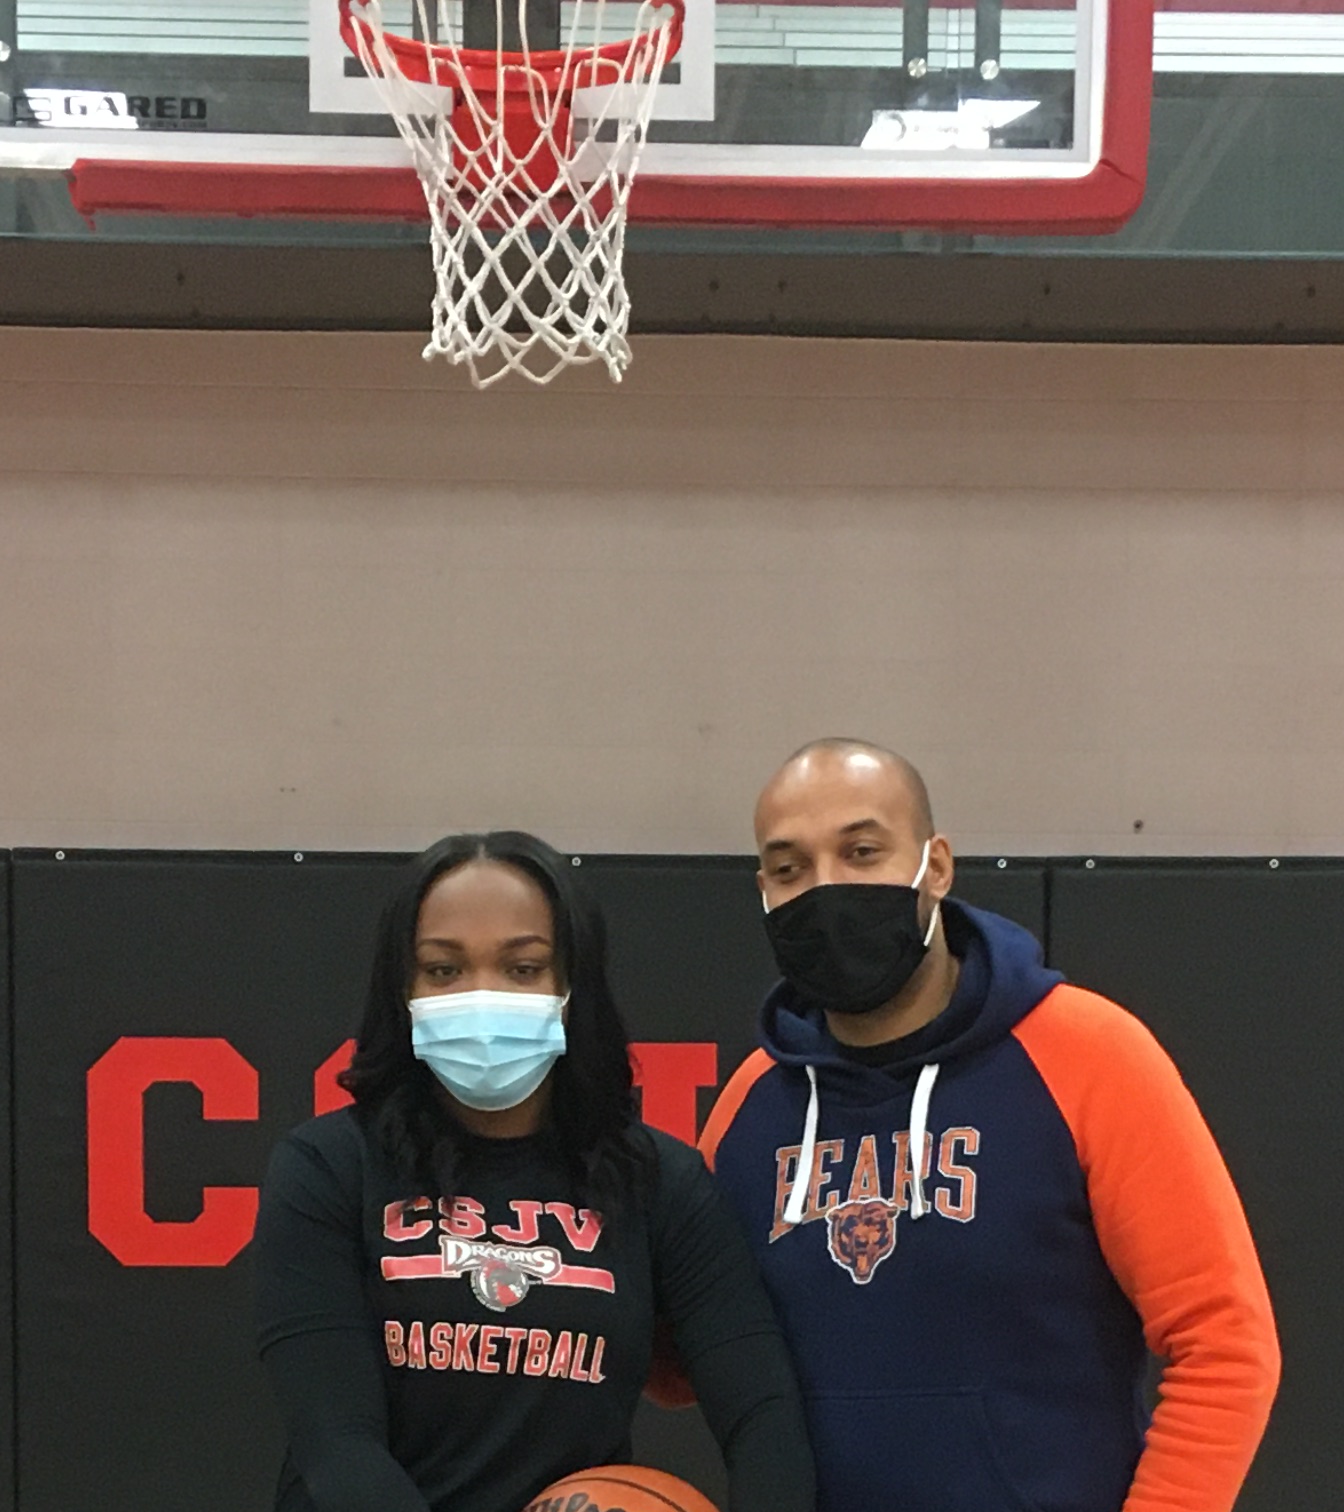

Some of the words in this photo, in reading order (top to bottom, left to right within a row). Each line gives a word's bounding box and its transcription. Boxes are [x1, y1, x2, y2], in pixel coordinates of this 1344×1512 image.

[63, 95, 207, 118] GARED
[383, 1195, 605, 1252] CSJV
[445, 1238, 556, 1274] DRAGONS
[384, 1320, 606, 1384] BASKETBALL
